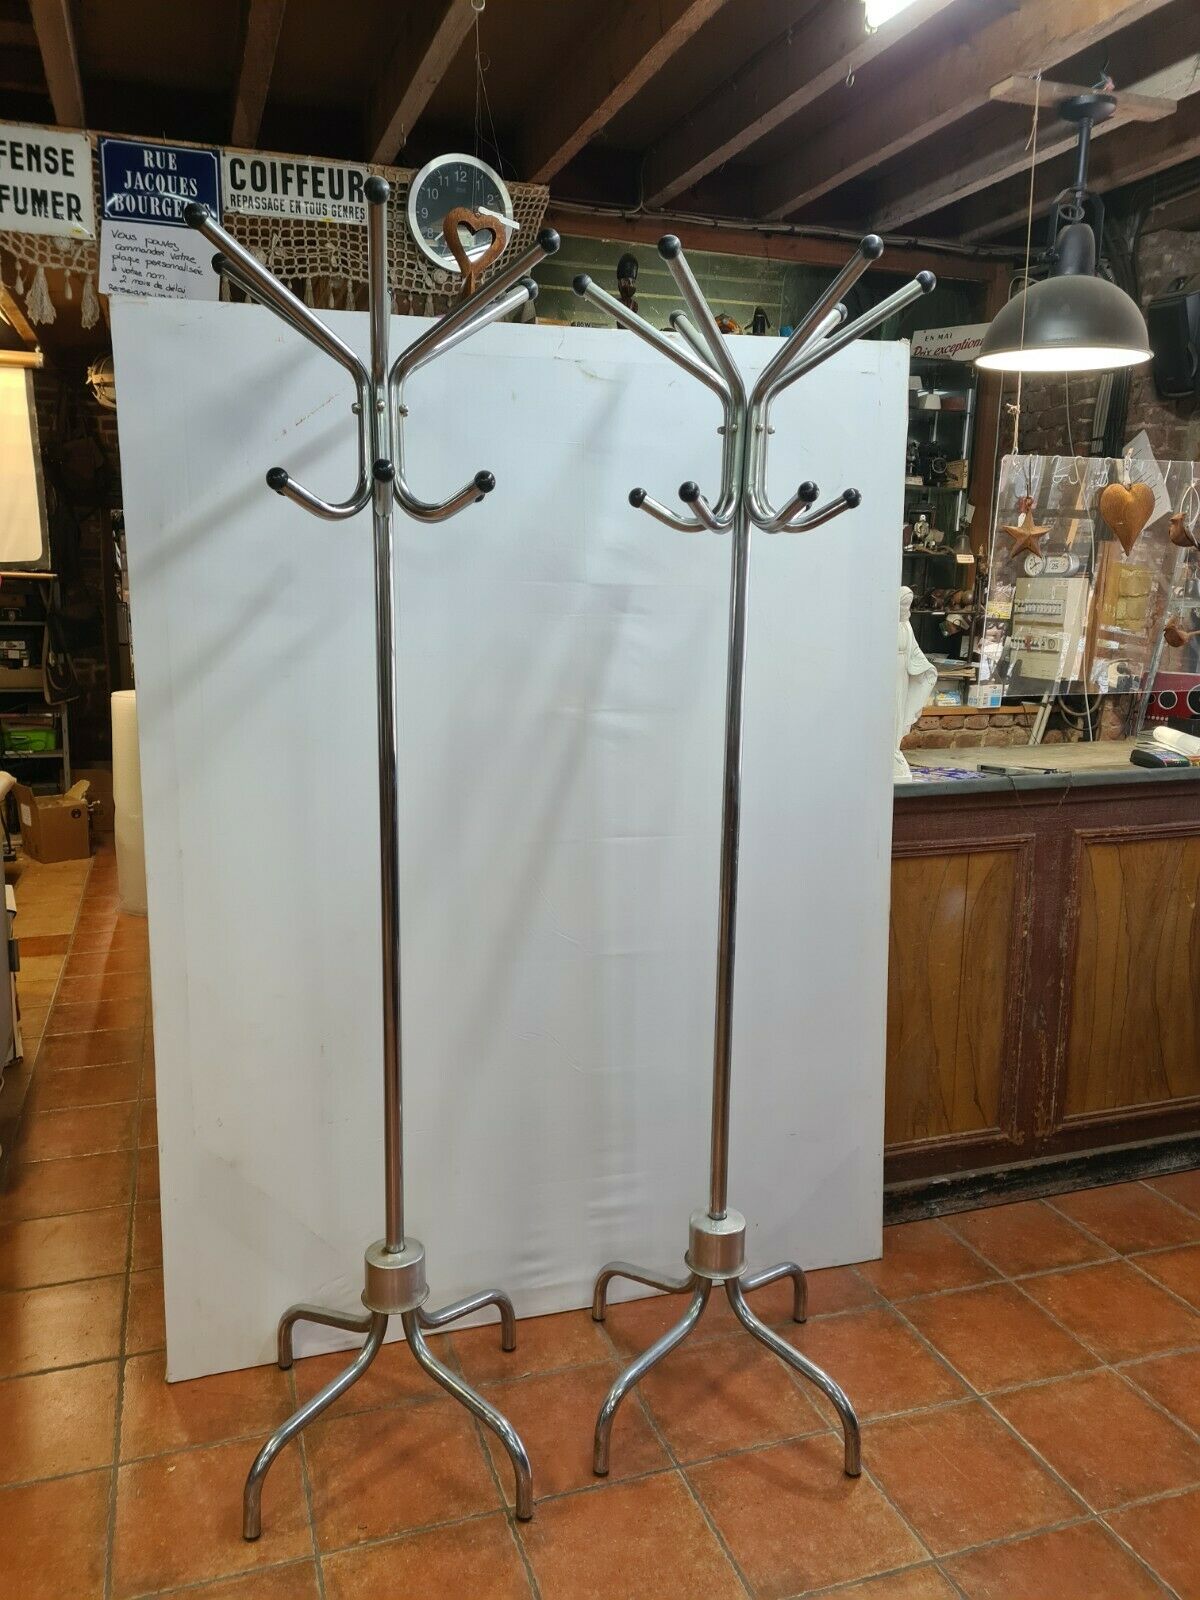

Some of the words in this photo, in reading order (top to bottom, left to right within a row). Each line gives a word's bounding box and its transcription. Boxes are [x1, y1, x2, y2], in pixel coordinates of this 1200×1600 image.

[143, 149, 177, 170] RUE
[229, 157, 364, 204] COIFFEUR
[438, 175, 449, 188] 11
[455, 171, 467, 182] 12
[124, 170, 197, 197] JACQUES
[427, 188, 439, 200] 10
[487, 194, 494, 205] 2
[0, 184, 83, 222] FUMER
[113, 193, 211, 219] BOURGE
[230, 194, 285, 212] REPASSAGE
[289, 199, 301, 214] EN
[304, 201, 328, 216] TOUS
[331, 204, 365, 220] GENRES
[421, 207, 429, 218] 9
[112, 229, 137, 241] Vous
[427, 227, 434, 238] 8
[119, 275, 127, 283] 2
[933, 338, 984, 357] exception
